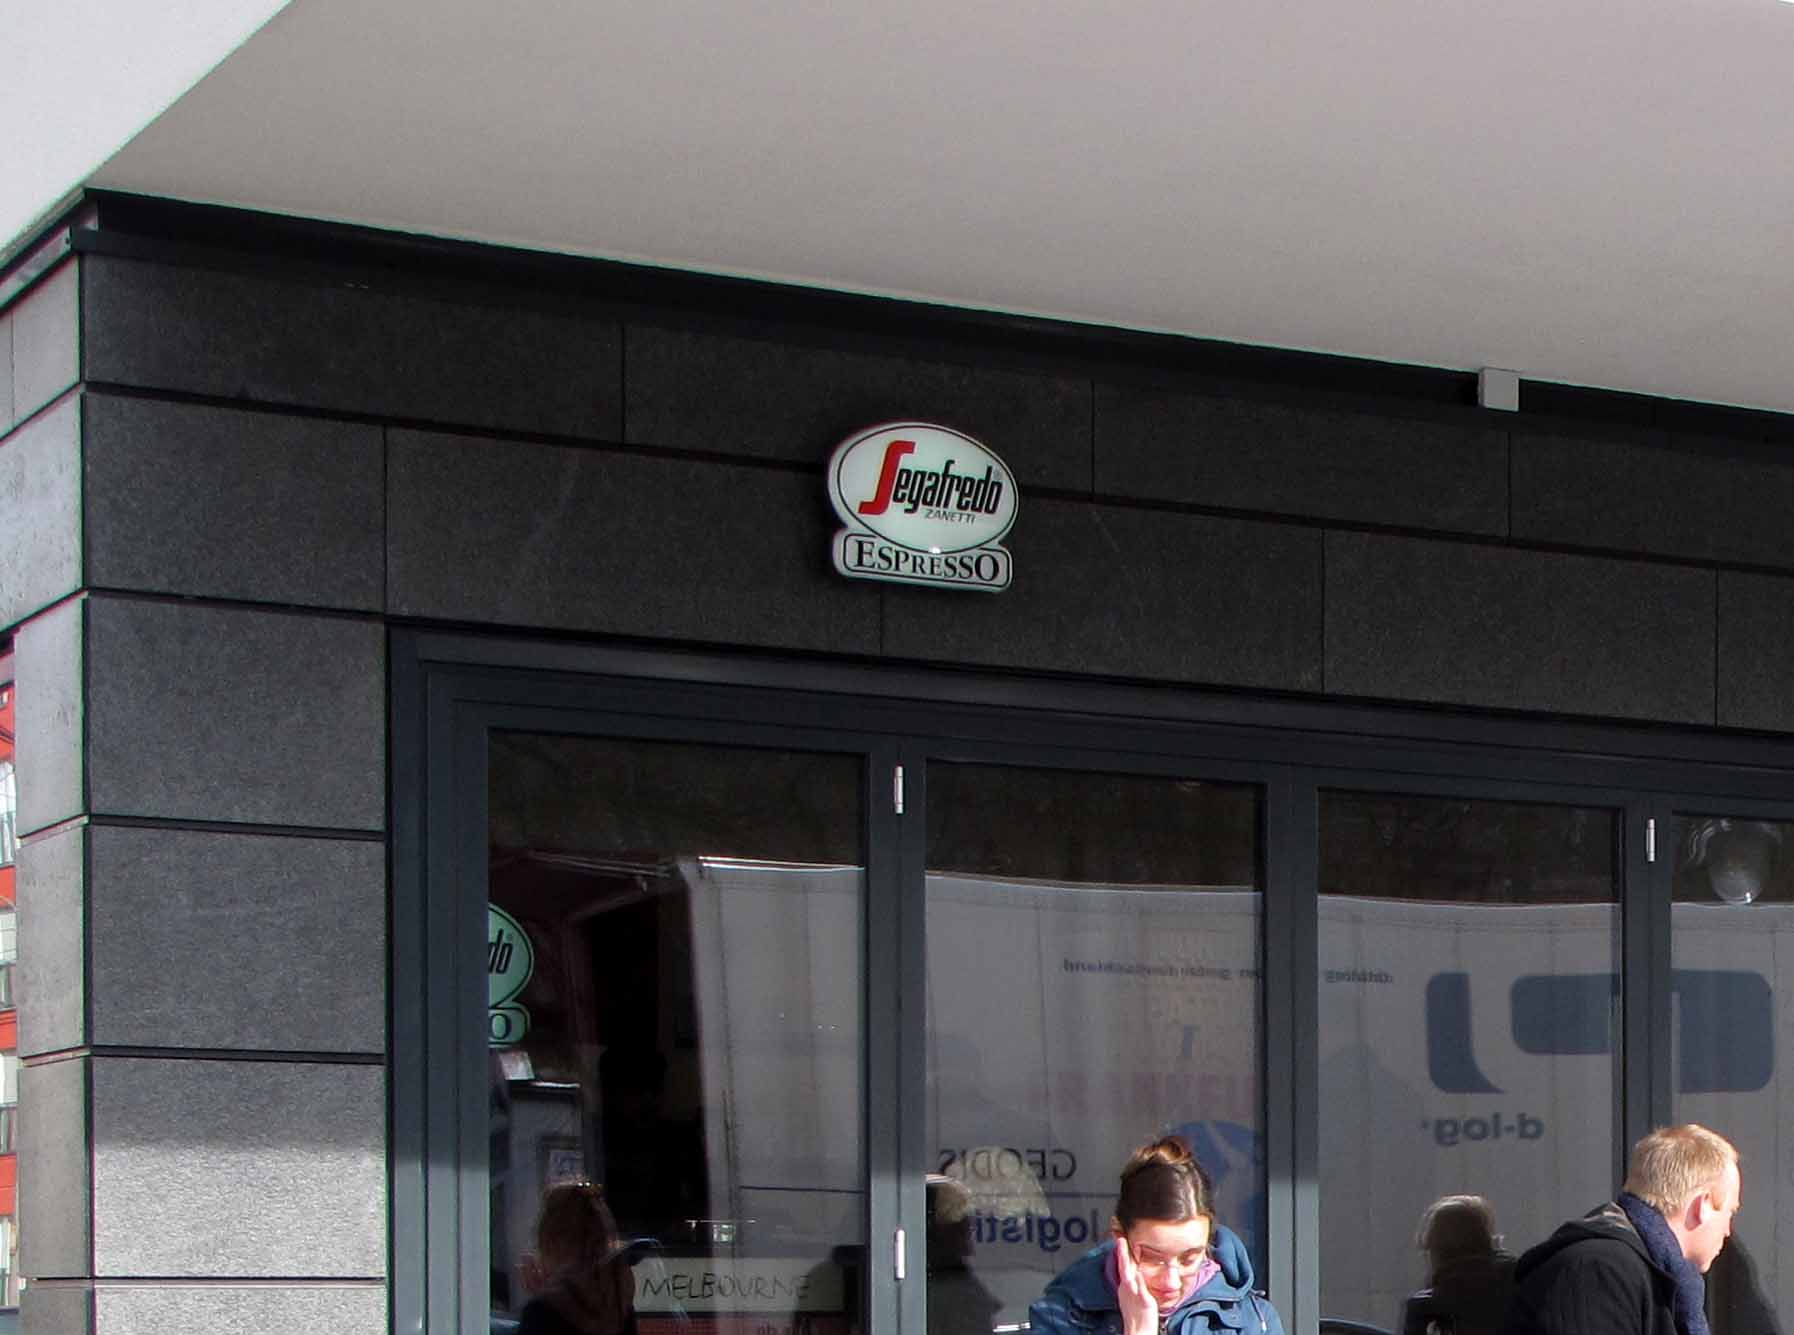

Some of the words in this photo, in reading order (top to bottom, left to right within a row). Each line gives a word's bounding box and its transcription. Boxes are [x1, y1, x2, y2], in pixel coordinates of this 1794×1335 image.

[857, 440, 1003, 515] Segafredo
[924, 509, 976, 525] ZANETTI
[642, 1272, 809, 1300] MELBOURNE
